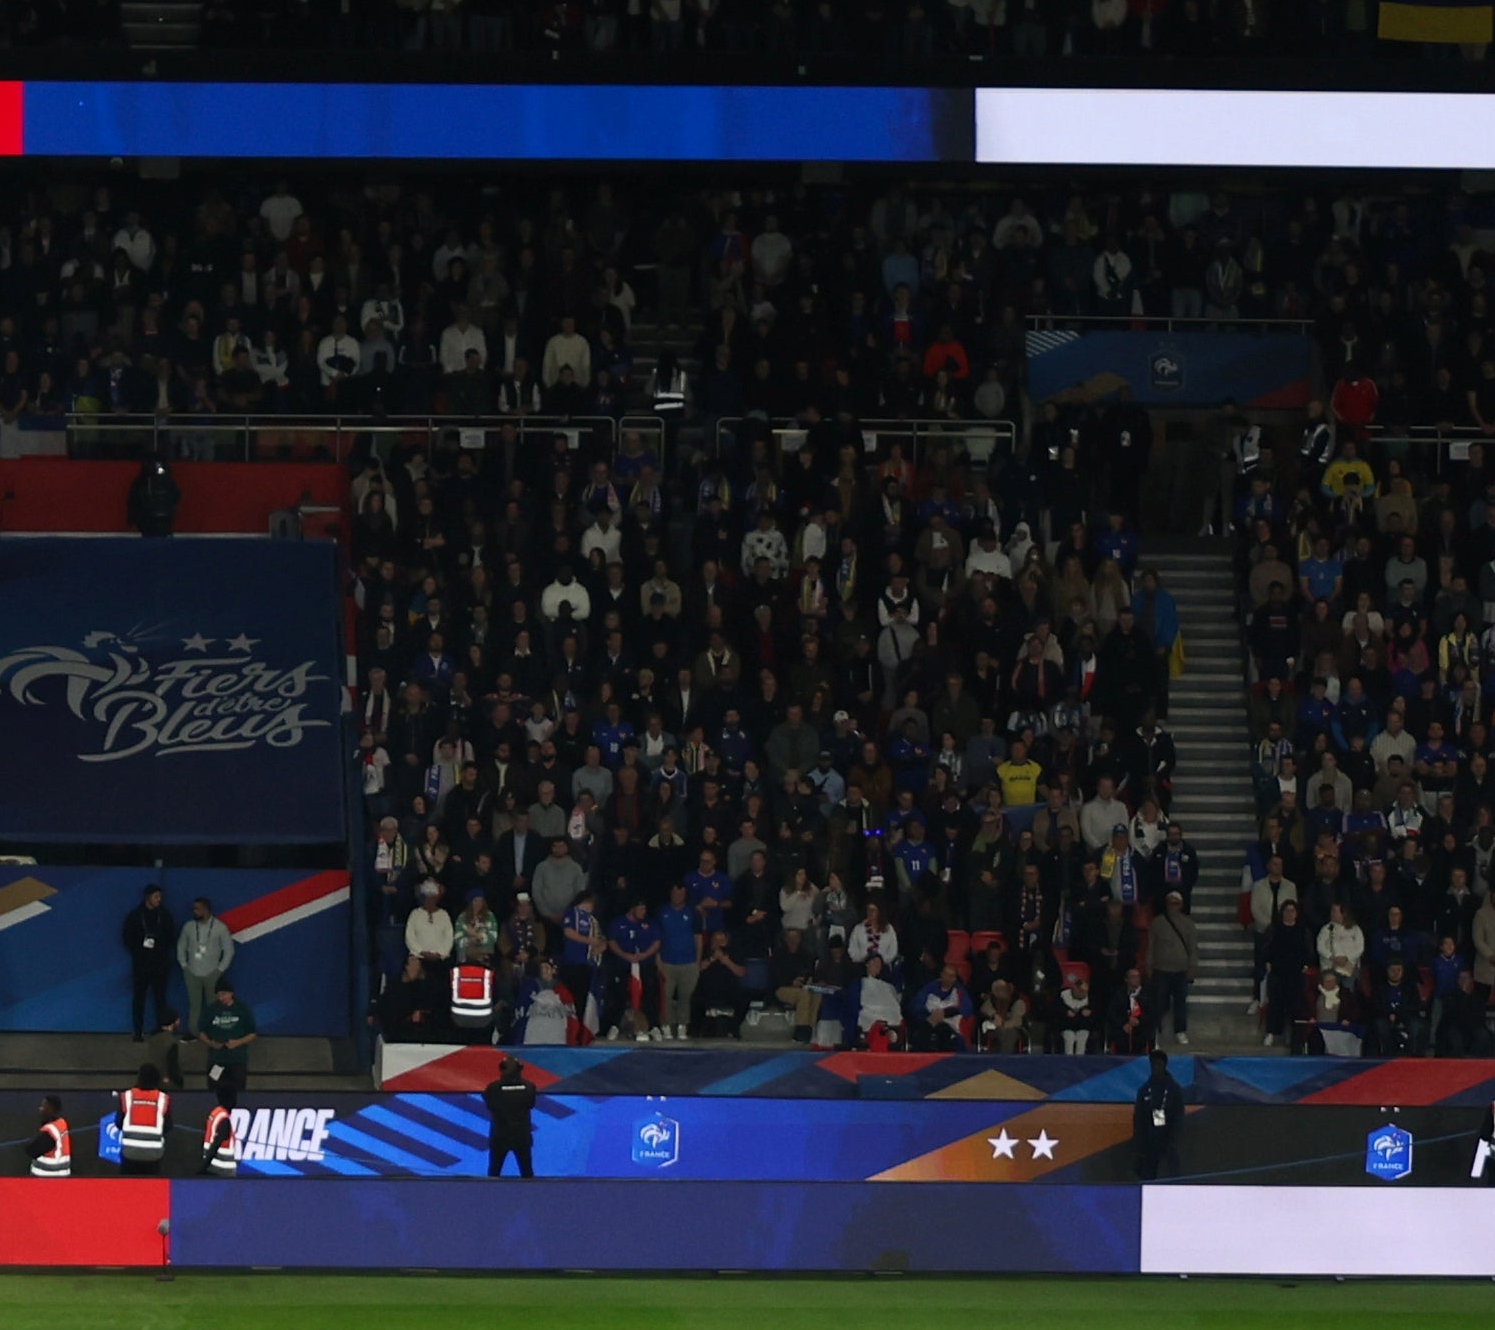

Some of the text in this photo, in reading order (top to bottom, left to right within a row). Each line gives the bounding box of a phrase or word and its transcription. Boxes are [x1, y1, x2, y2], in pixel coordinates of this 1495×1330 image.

[153, 656, 330, 698] Fiers
[77, 690, 332, 762] Bleus
[230, 1108, 335, 1161] RANCE
[640, 1150, 670, 1158] FRANCE
[1373, 1163, 1404, 1171] FRANCE
